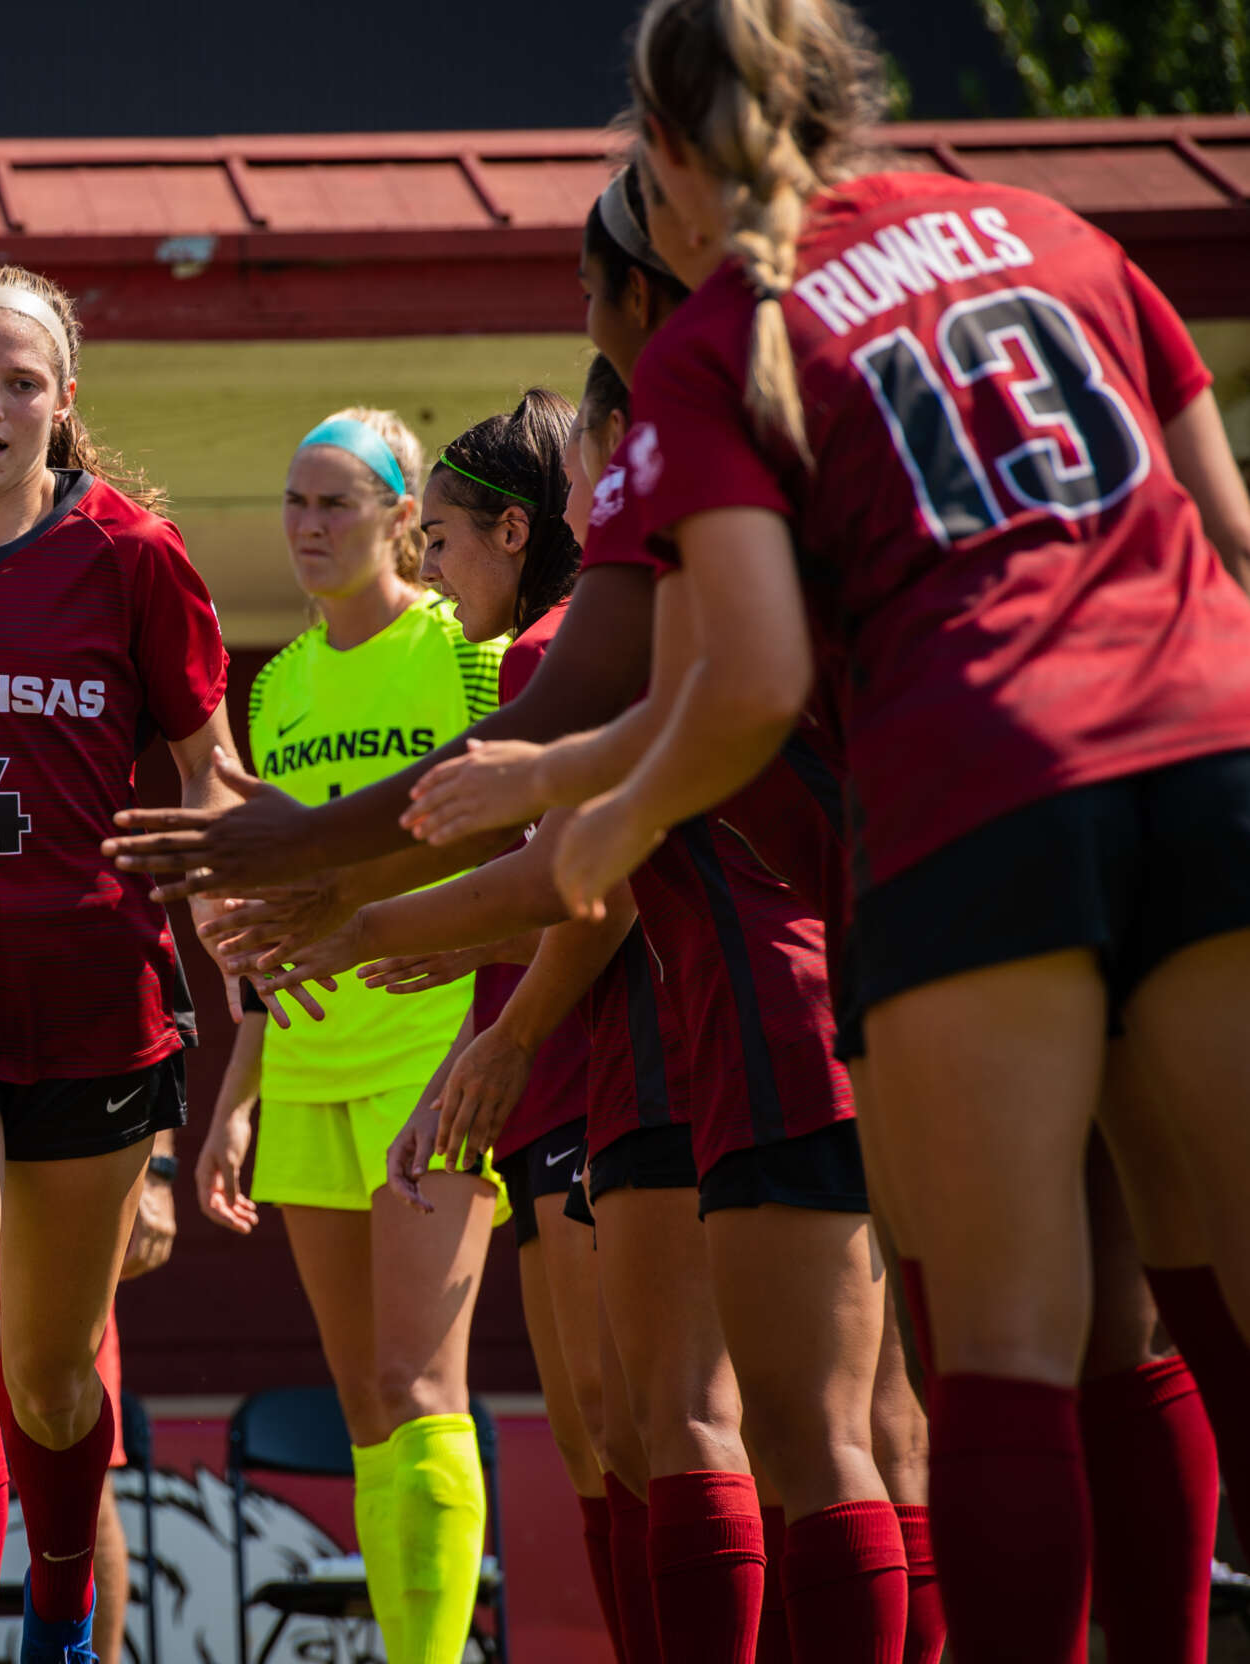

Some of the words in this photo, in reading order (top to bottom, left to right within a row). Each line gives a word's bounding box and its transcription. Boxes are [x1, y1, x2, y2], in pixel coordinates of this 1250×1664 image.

[793, 206, 1034, 336] RUNNELS
[851, 285, 1150, 548] 13
[263, 726, 435, 779] ARKANSAS
